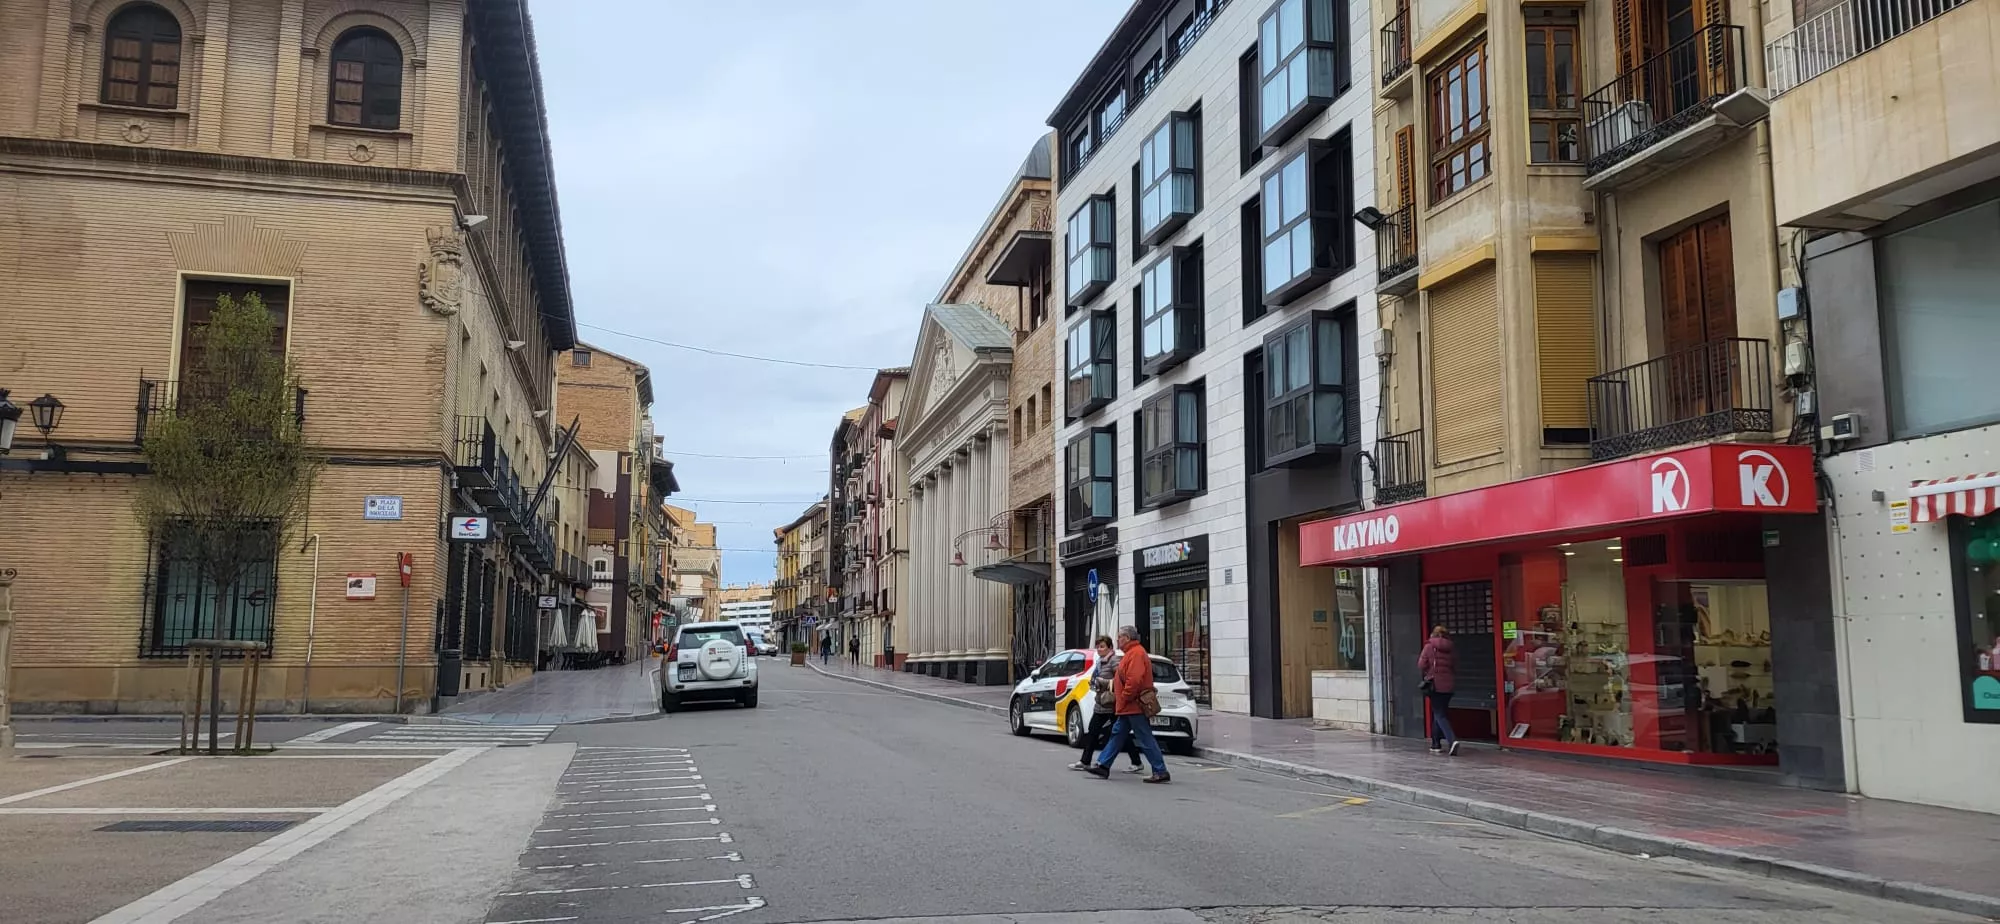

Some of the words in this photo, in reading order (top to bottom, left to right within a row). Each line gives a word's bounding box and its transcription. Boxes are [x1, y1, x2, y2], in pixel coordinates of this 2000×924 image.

[1651, 469, 1682, 513] K
[1739, 464, 1779, 507] K
[1334, 515, 1399, 552] KAYMO
